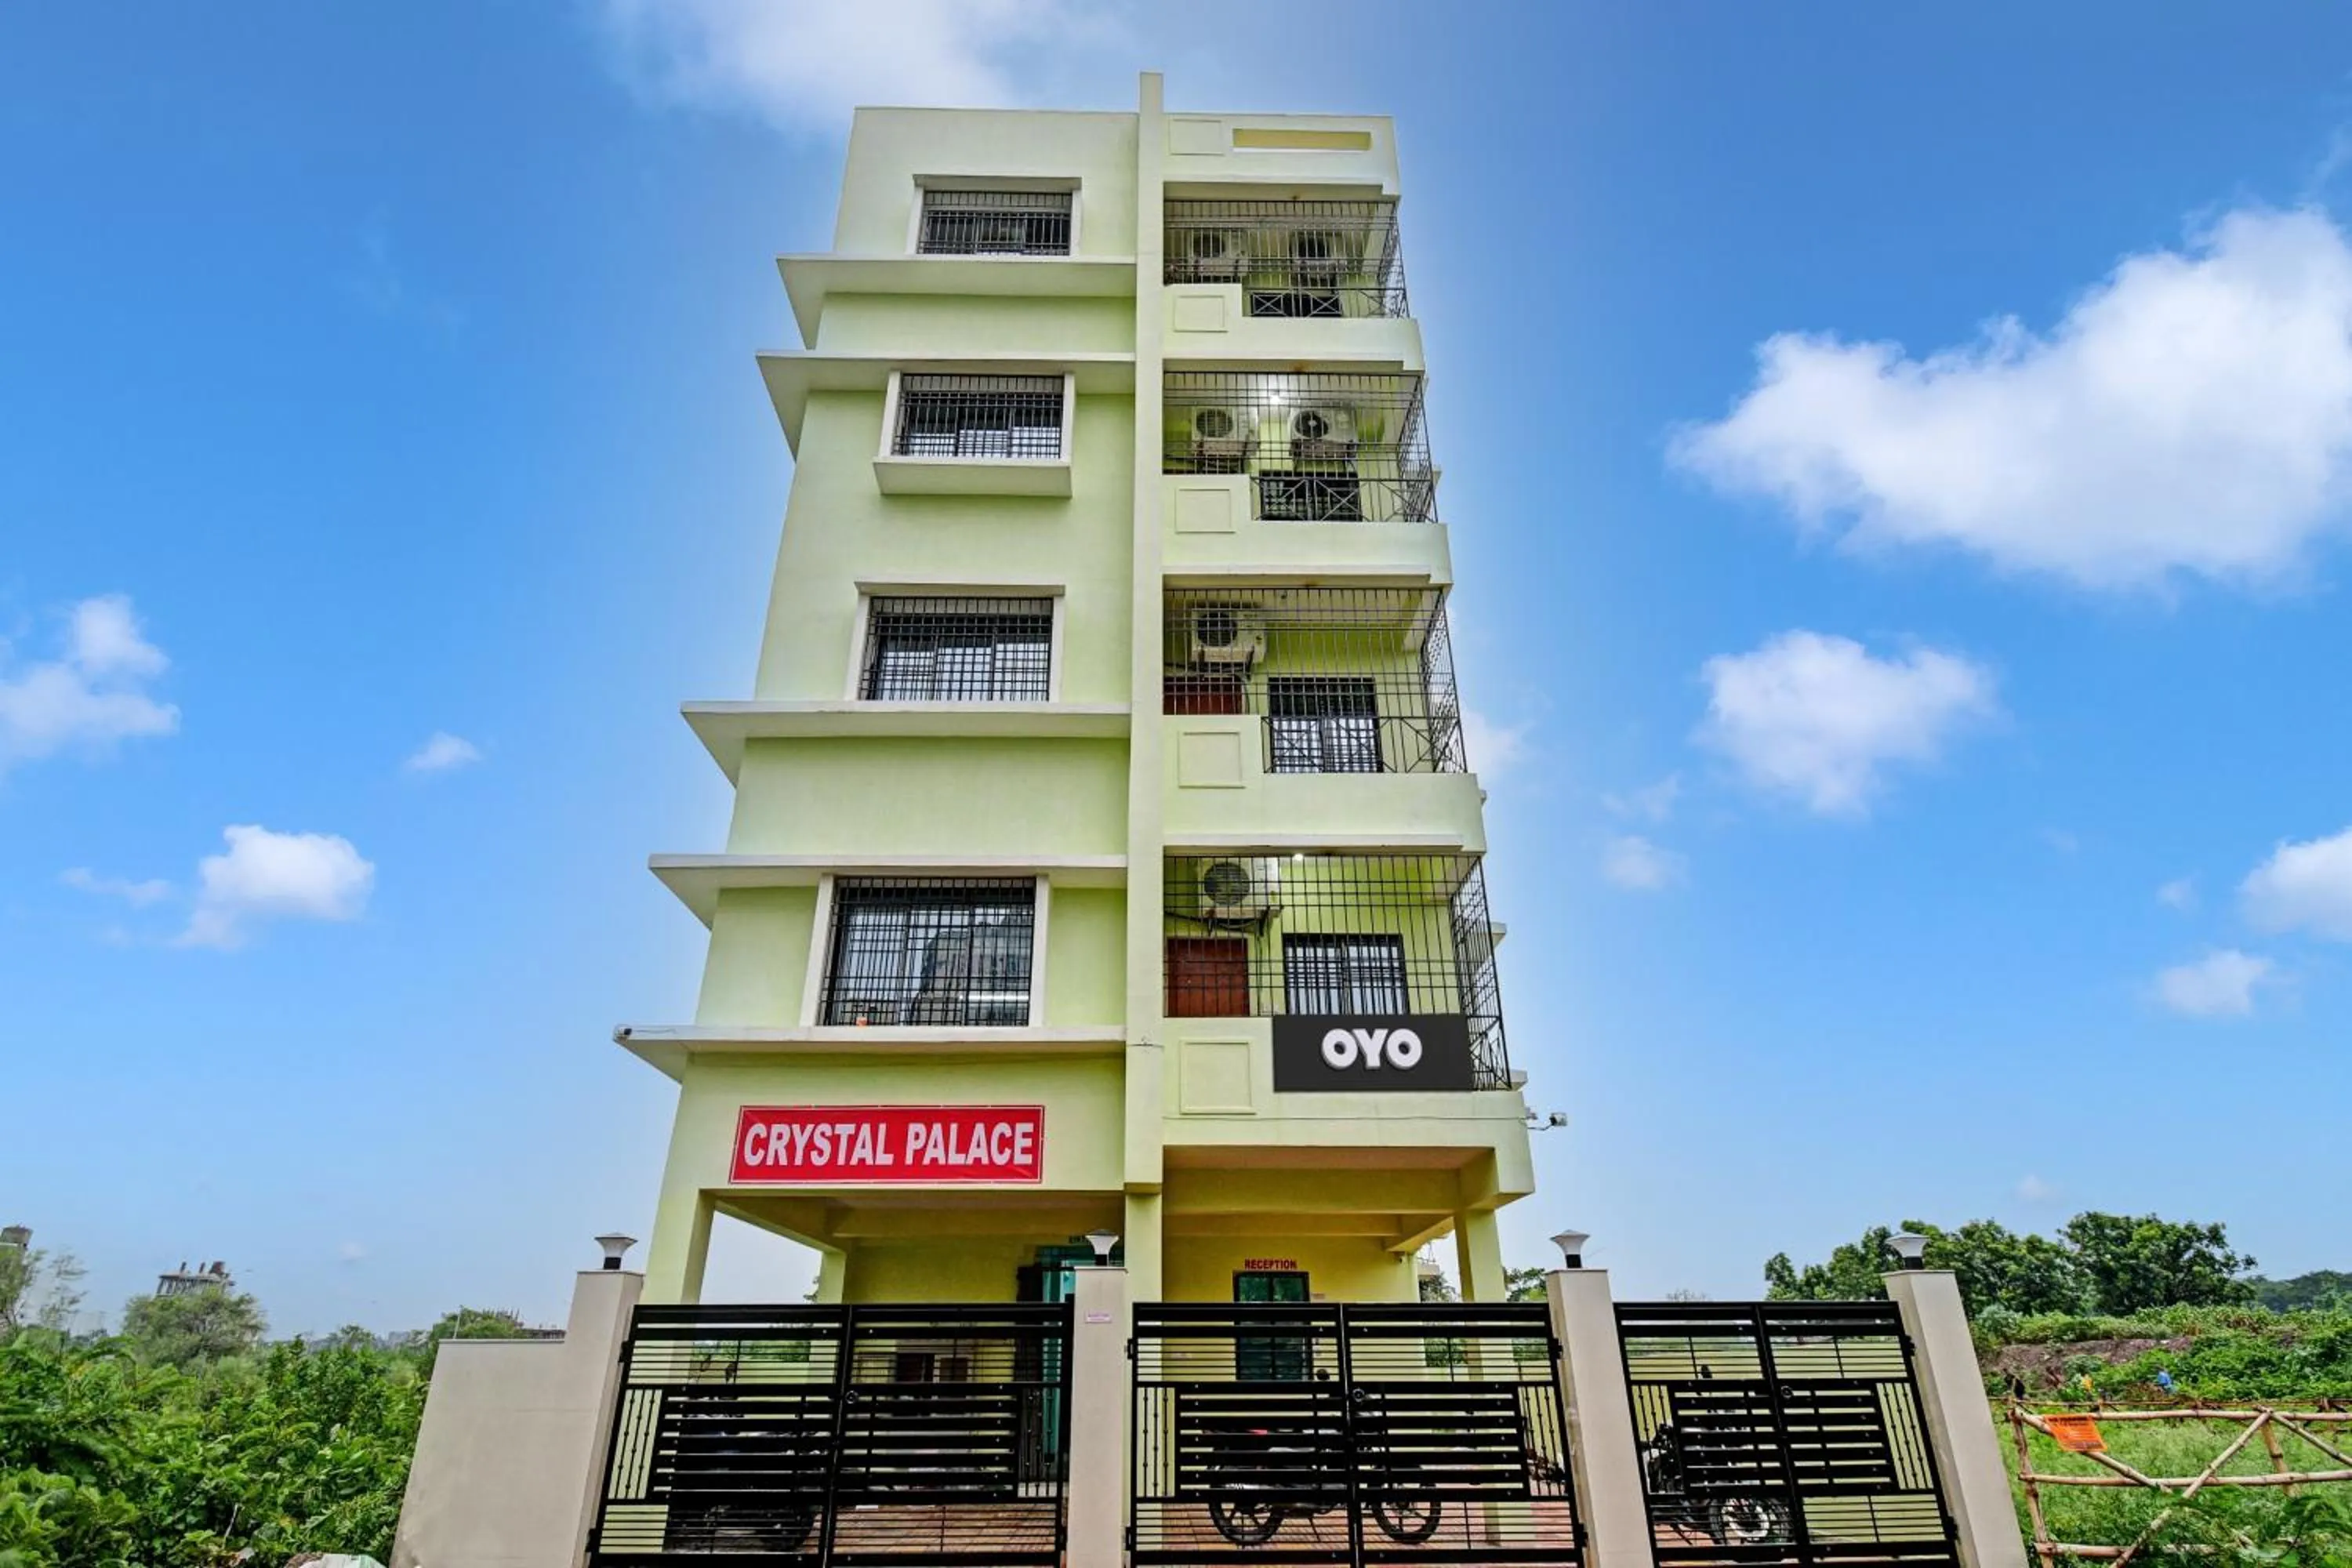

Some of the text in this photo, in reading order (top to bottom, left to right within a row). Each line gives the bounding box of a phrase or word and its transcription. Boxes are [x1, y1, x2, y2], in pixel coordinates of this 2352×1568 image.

[1321, 1028, 1422, 1069] OYO
[743, 1122, 1034, 1167] CRYSTAL PALACE
[1244, 1258, 1298, 1269] RECEPTION
